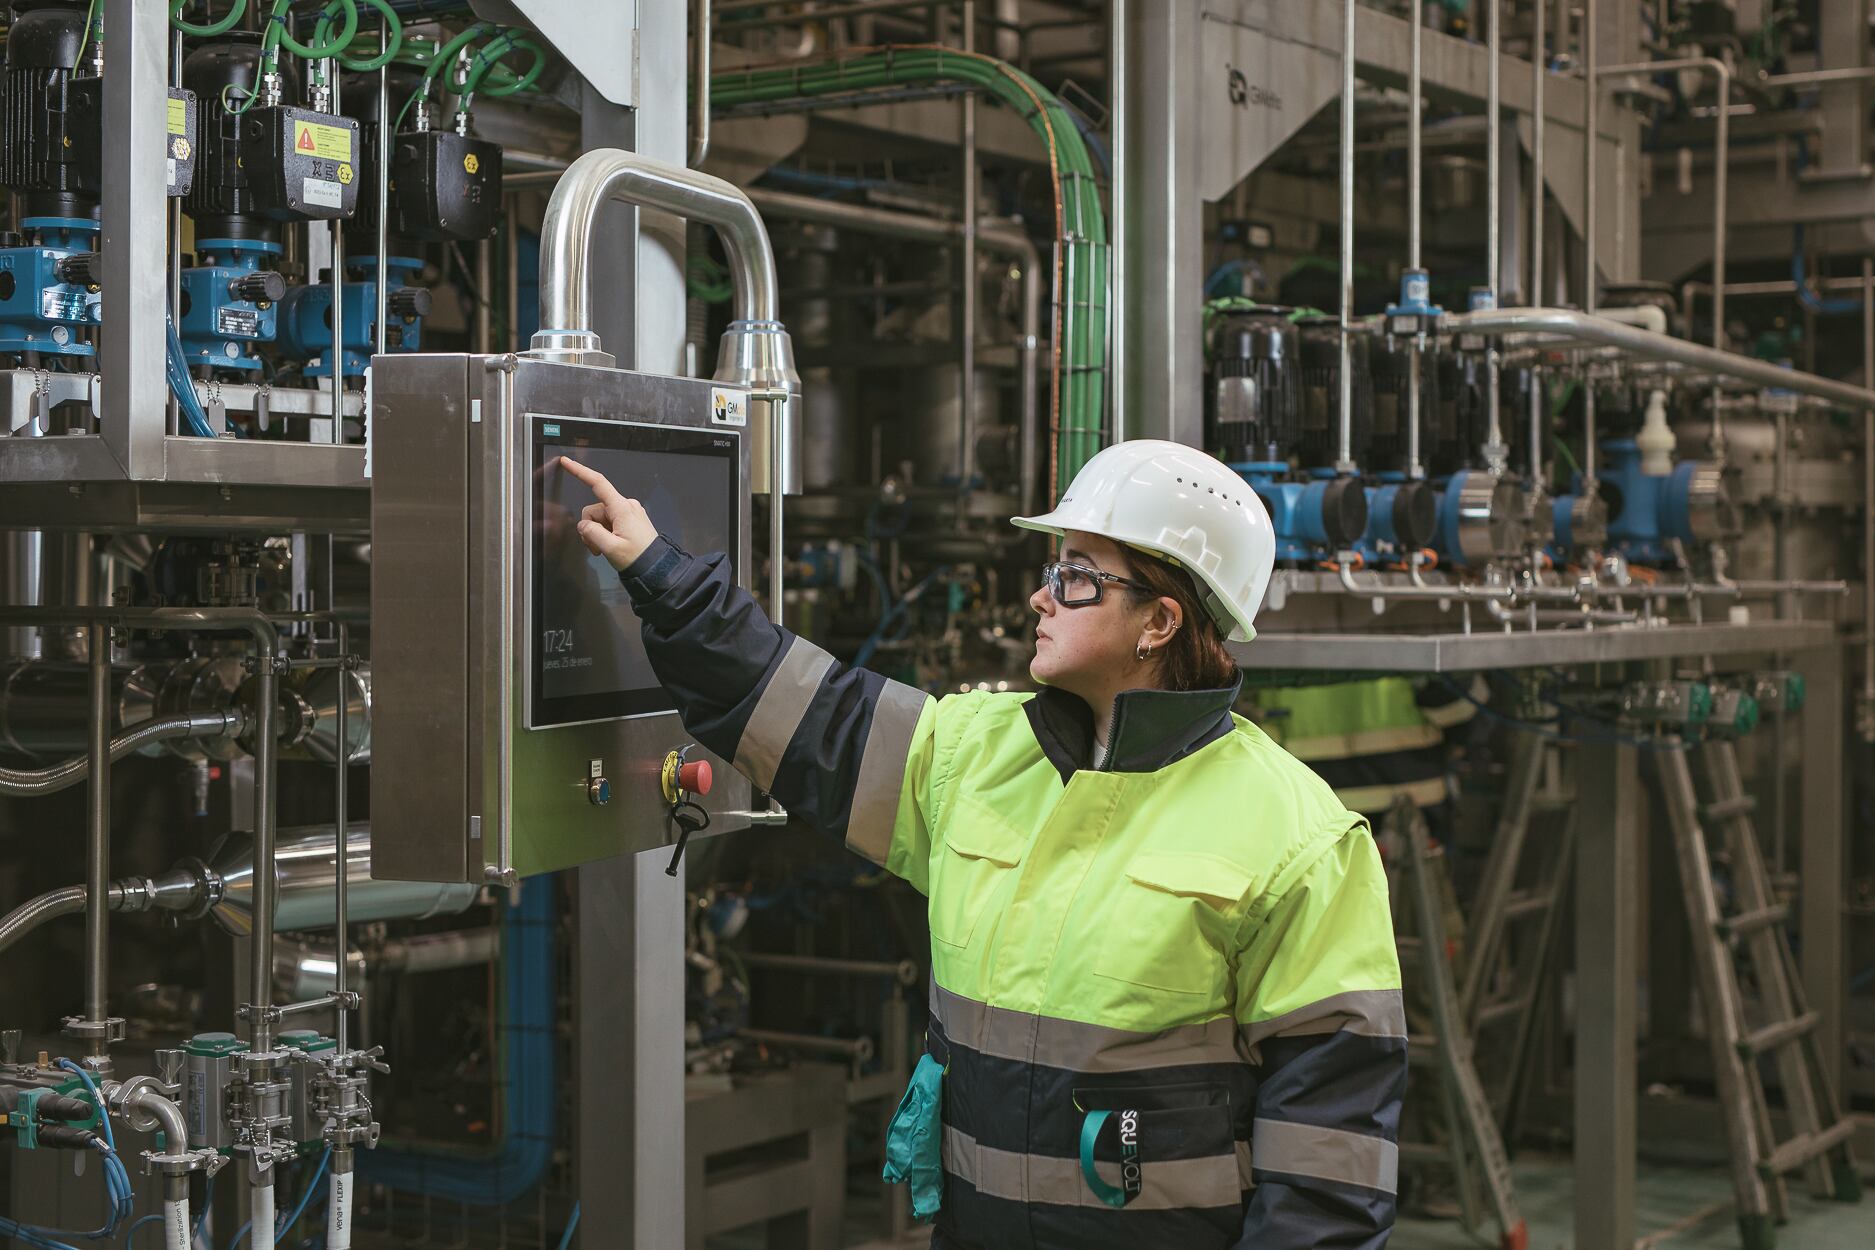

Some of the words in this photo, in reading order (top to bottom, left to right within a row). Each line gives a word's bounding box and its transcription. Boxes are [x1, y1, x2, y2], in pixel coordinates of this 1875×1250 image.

[543, 629, 573, 653] 17:24
[1120, 1109, 1140, 1192] SQUEVOLT
[174, 1207, 186, 1246] Sterilization
